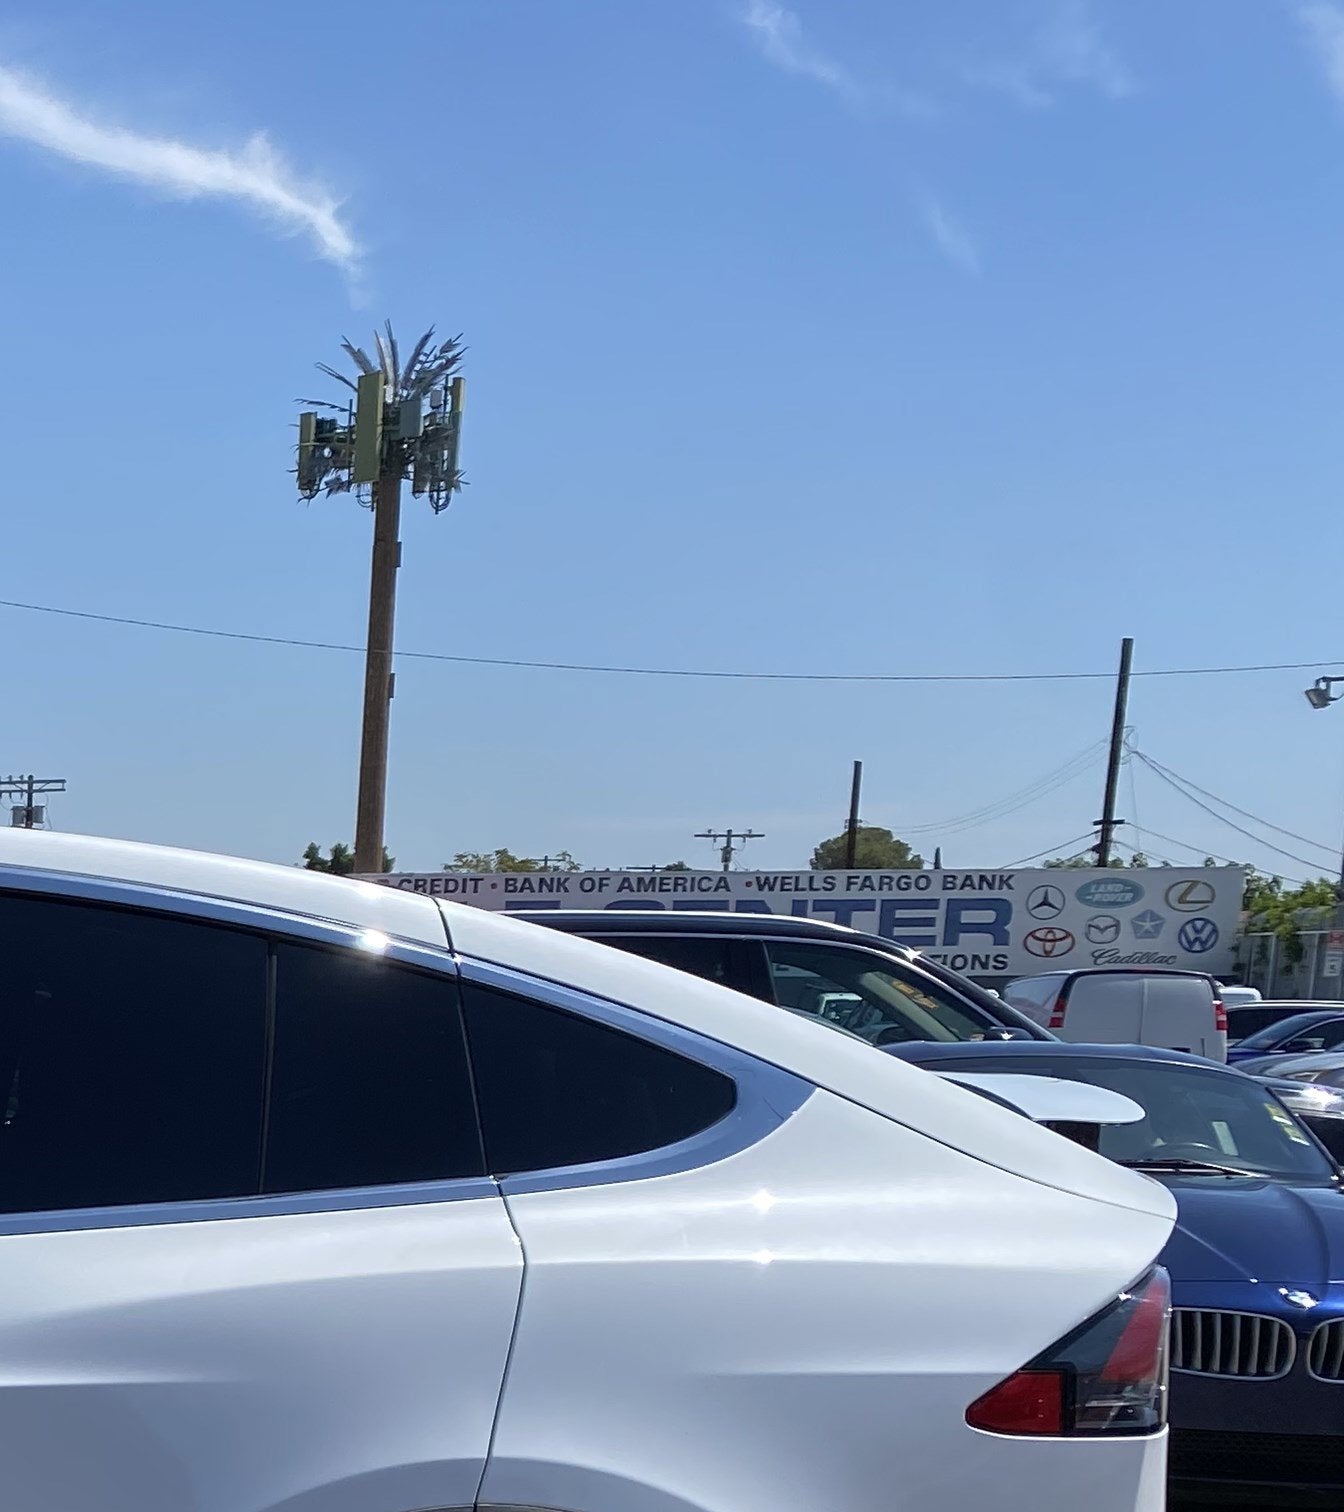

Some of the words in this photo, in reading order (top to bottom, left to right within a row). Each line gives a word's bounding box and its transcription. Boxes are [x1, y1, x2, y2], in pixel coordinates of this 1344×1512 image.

[397, 877, 485, 895] CREDIT
[504, 876, 571, 893] BANK
[579, 876, 612, 893] OF
[616, 875, 732, 893] AMERICA
[755, 875, 838, 892] WELLS
[845, 874, 932, 892] FARGO
[942, 874, 1015, 891] BANK
[929, 953, 1009, 971] IONS
[1091, 947, 1178, 966] Cadillac
